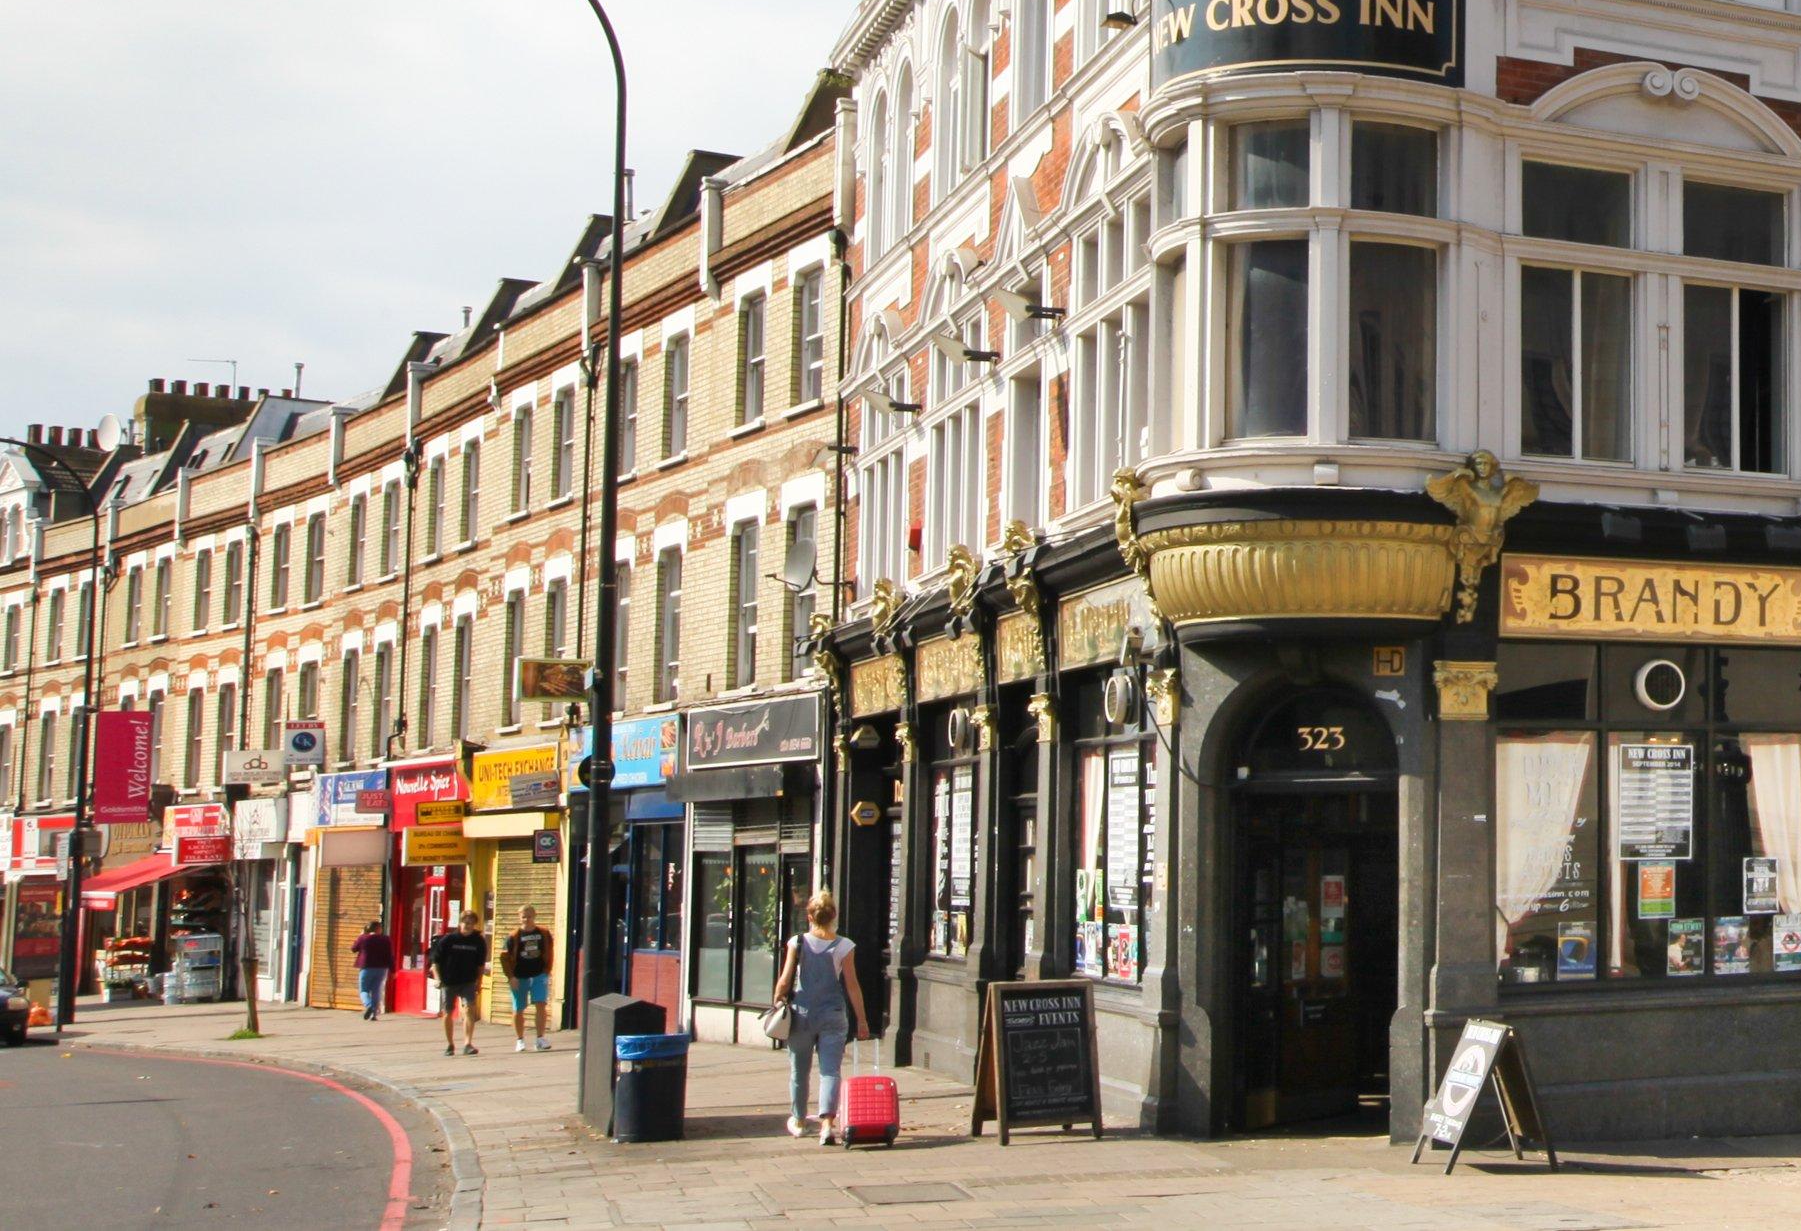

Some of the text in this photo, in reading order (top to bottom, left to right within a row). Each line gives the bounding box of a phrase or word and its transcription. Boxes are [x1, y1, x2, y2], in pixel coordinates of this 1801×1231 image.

[1152, 3, 1196, 56] NEW
[1548, 573, 1781, 627] BRANDY
[1297, 727, 1345, 751] 323
[128, 720, 150, 799] Welcome!
[1628, 748, 1686, 759] NEW CROSS INN
[361, 792, 383, 800] JUST
[100, 806, 147, 814] Goldsmiths
[1004, 996, 1082, 1012] NEW CROSS INN
[1039, 1011, 1080, 1026] EVENTS
[1050, 1031, 1076, 1050] Jam
